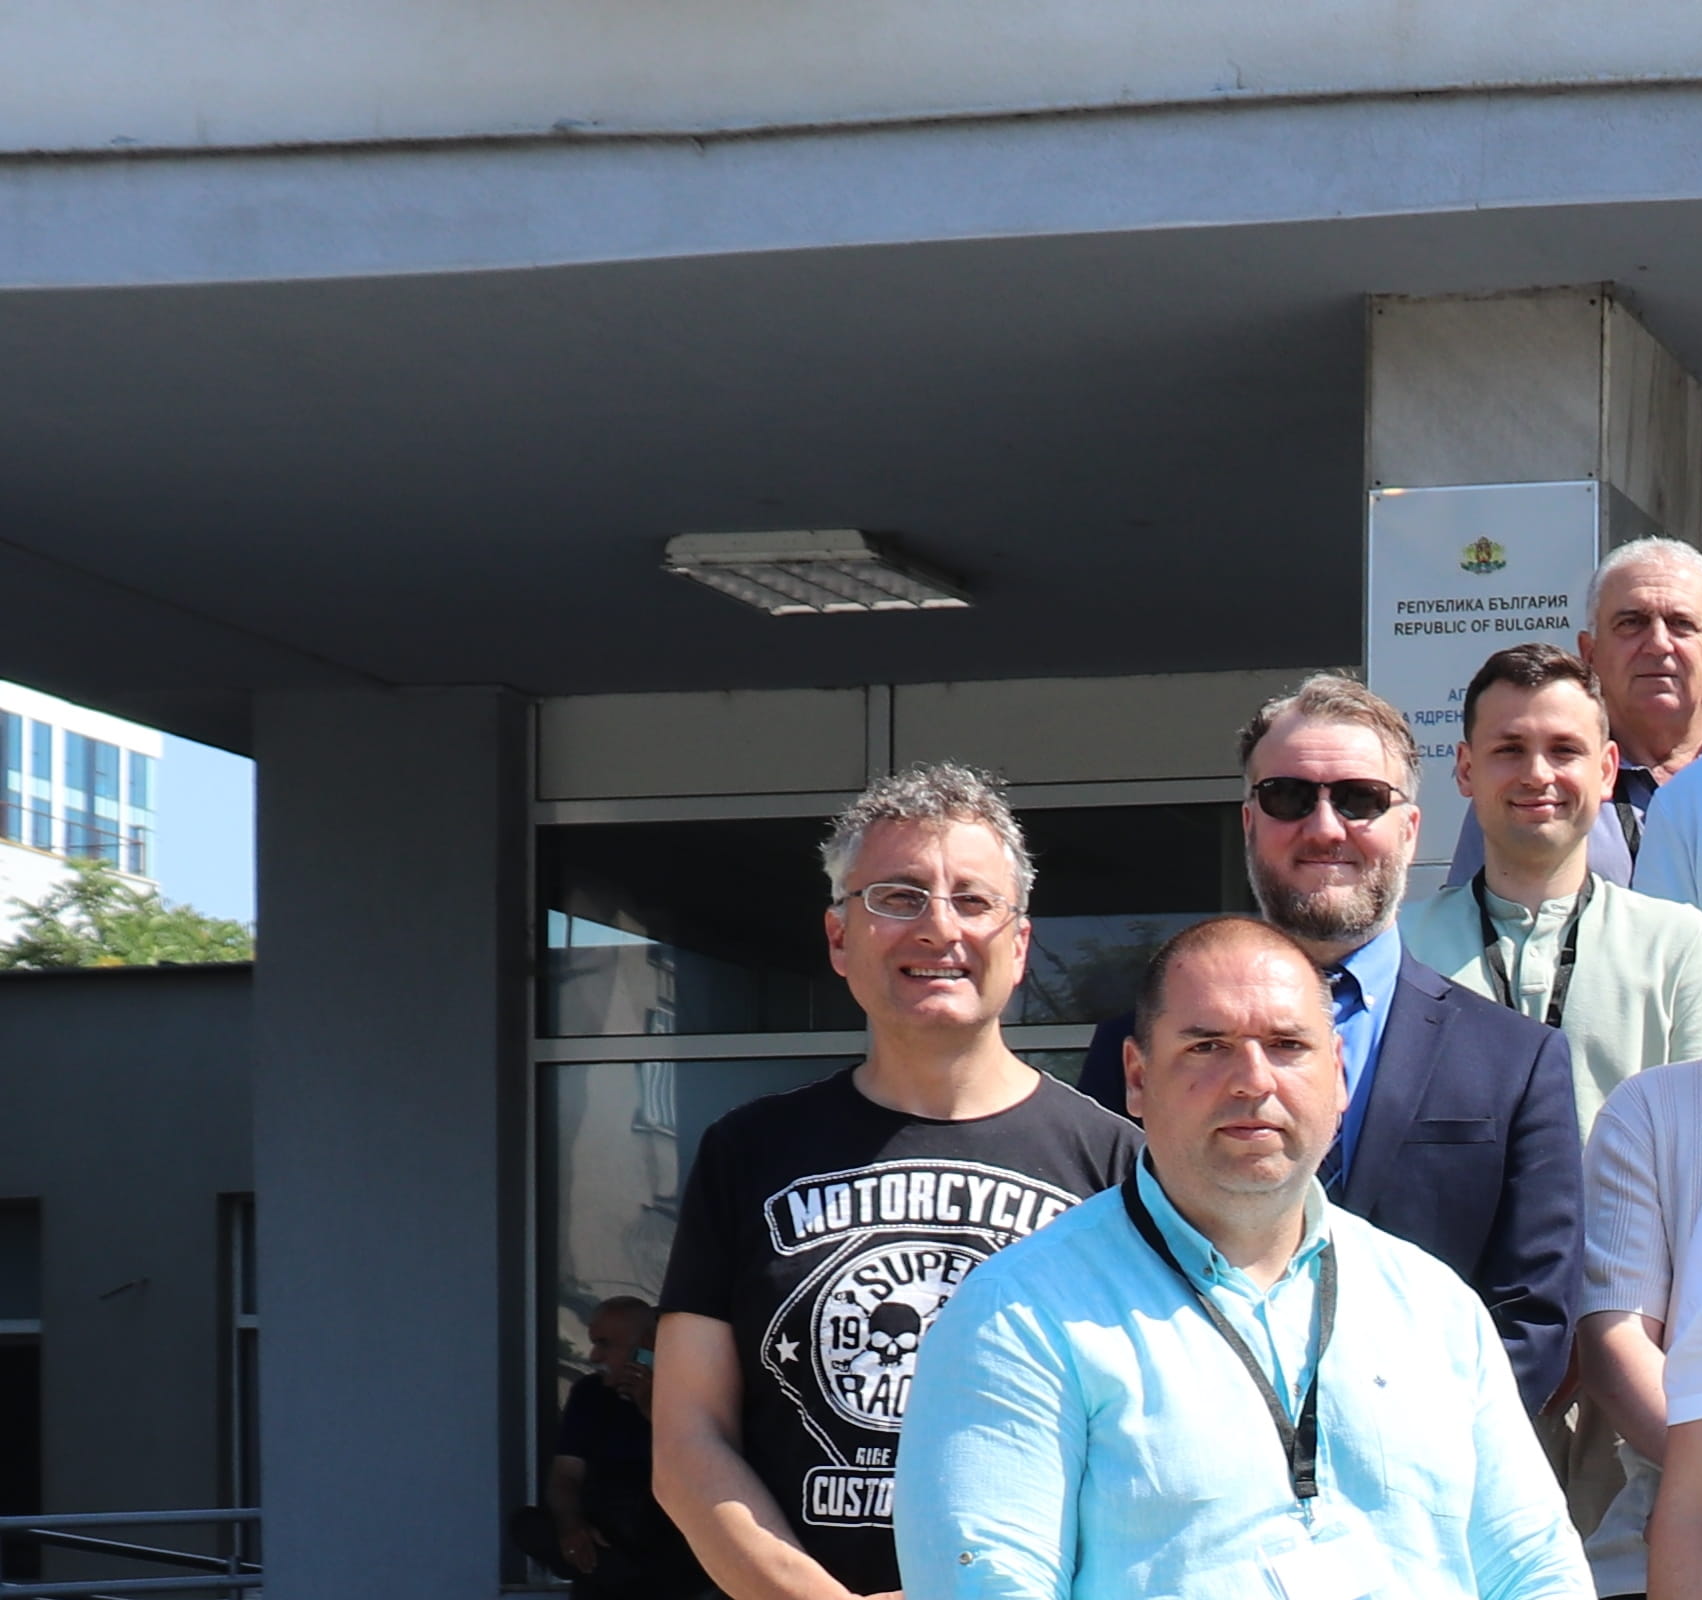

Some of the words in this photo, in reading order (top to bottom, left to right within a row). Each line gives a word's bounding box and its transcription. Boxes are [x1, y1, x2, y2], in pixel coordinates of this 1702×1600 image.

[1397, 598, 1485, 614] РЕПУБЛИКА
[1488, 594, 1569, 611] БЪЛГАРИЯ
[1394, 619, 1467, 636] REPUBLIC
[1471, 618, 1490, 633] OF
[1495, 616, 1570, 632] BULGARIA
[1414, 709, 1465, 726] ЯДРЕН
[1416, 743, 1456, 758] CLEA
[853, 1250, 978, 1302] SUPE
[829, 1315, 861, 1351] 19
[812, 1475, 896, 1518] CUSTO
